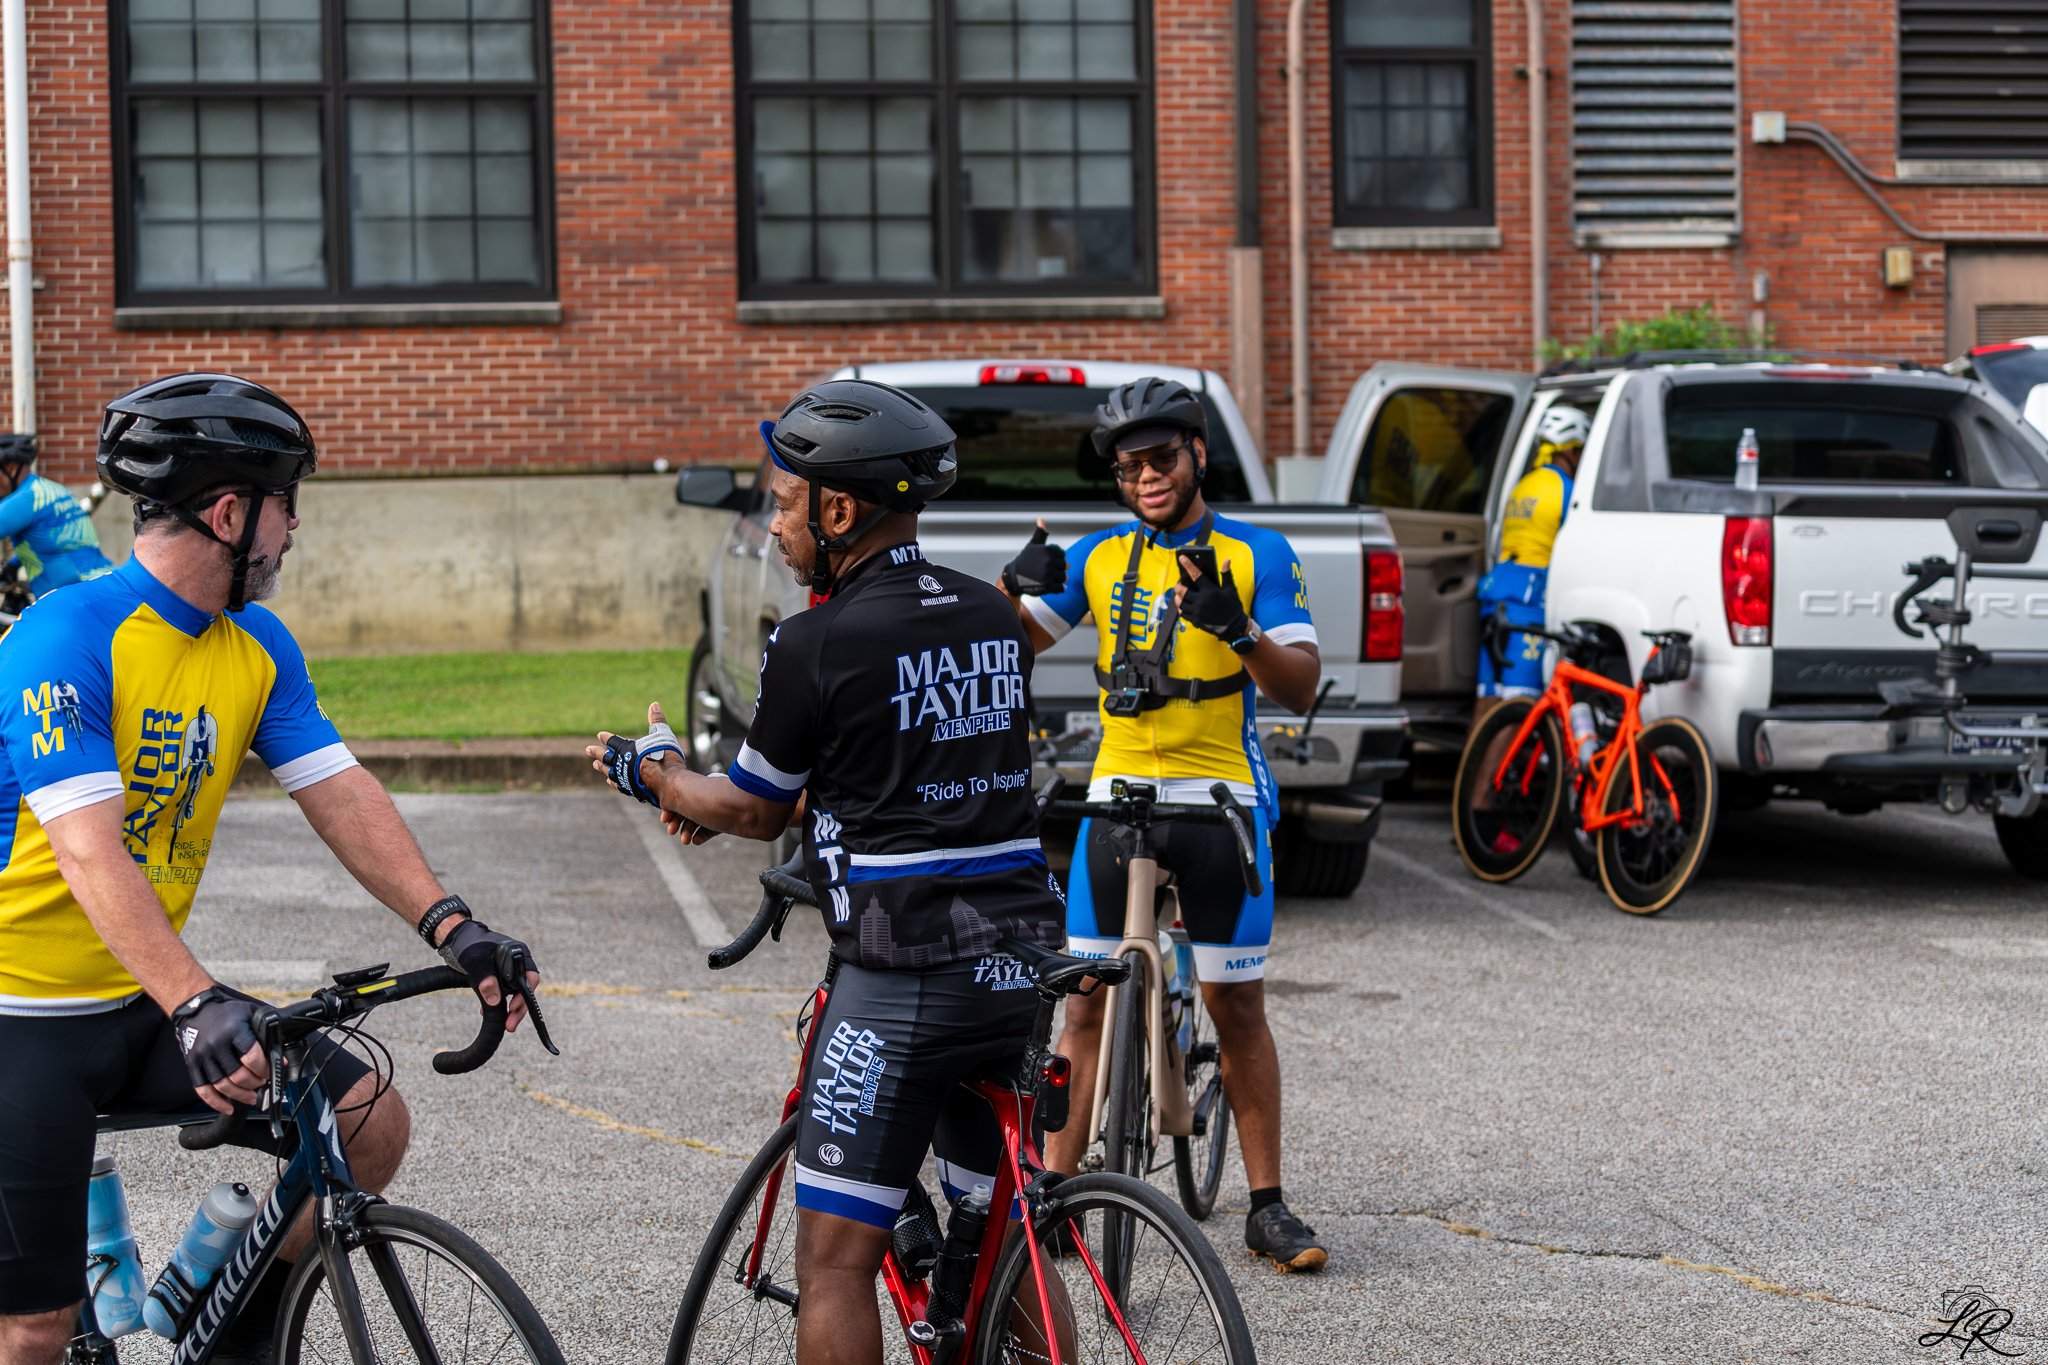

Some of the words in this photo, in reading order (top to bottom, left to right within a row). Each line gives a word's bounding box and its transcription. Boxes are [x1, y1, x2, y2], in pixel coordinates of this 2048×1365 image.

[920, 595, 959, 606] NIMBLEWEAR
[896, 639, 1020, 692] MAJOR
[22, 681, 65, 759] MTM
[890, 674, 1025, 731] TAYLOR
[930, 710, 1011, 742] MEMPHIS
[122, 708, 164, 847] AJOR
[968, 777, 988, 796] To
[174, 840, 196, 851] RIDE
[812, 808, 850, 922] MTM
[811, 1020, 861, 1126] MAJOR
[831, 1028, 887, 1136] TAYLOR
[858, 1055, 887, 1117] MEMPHIS
